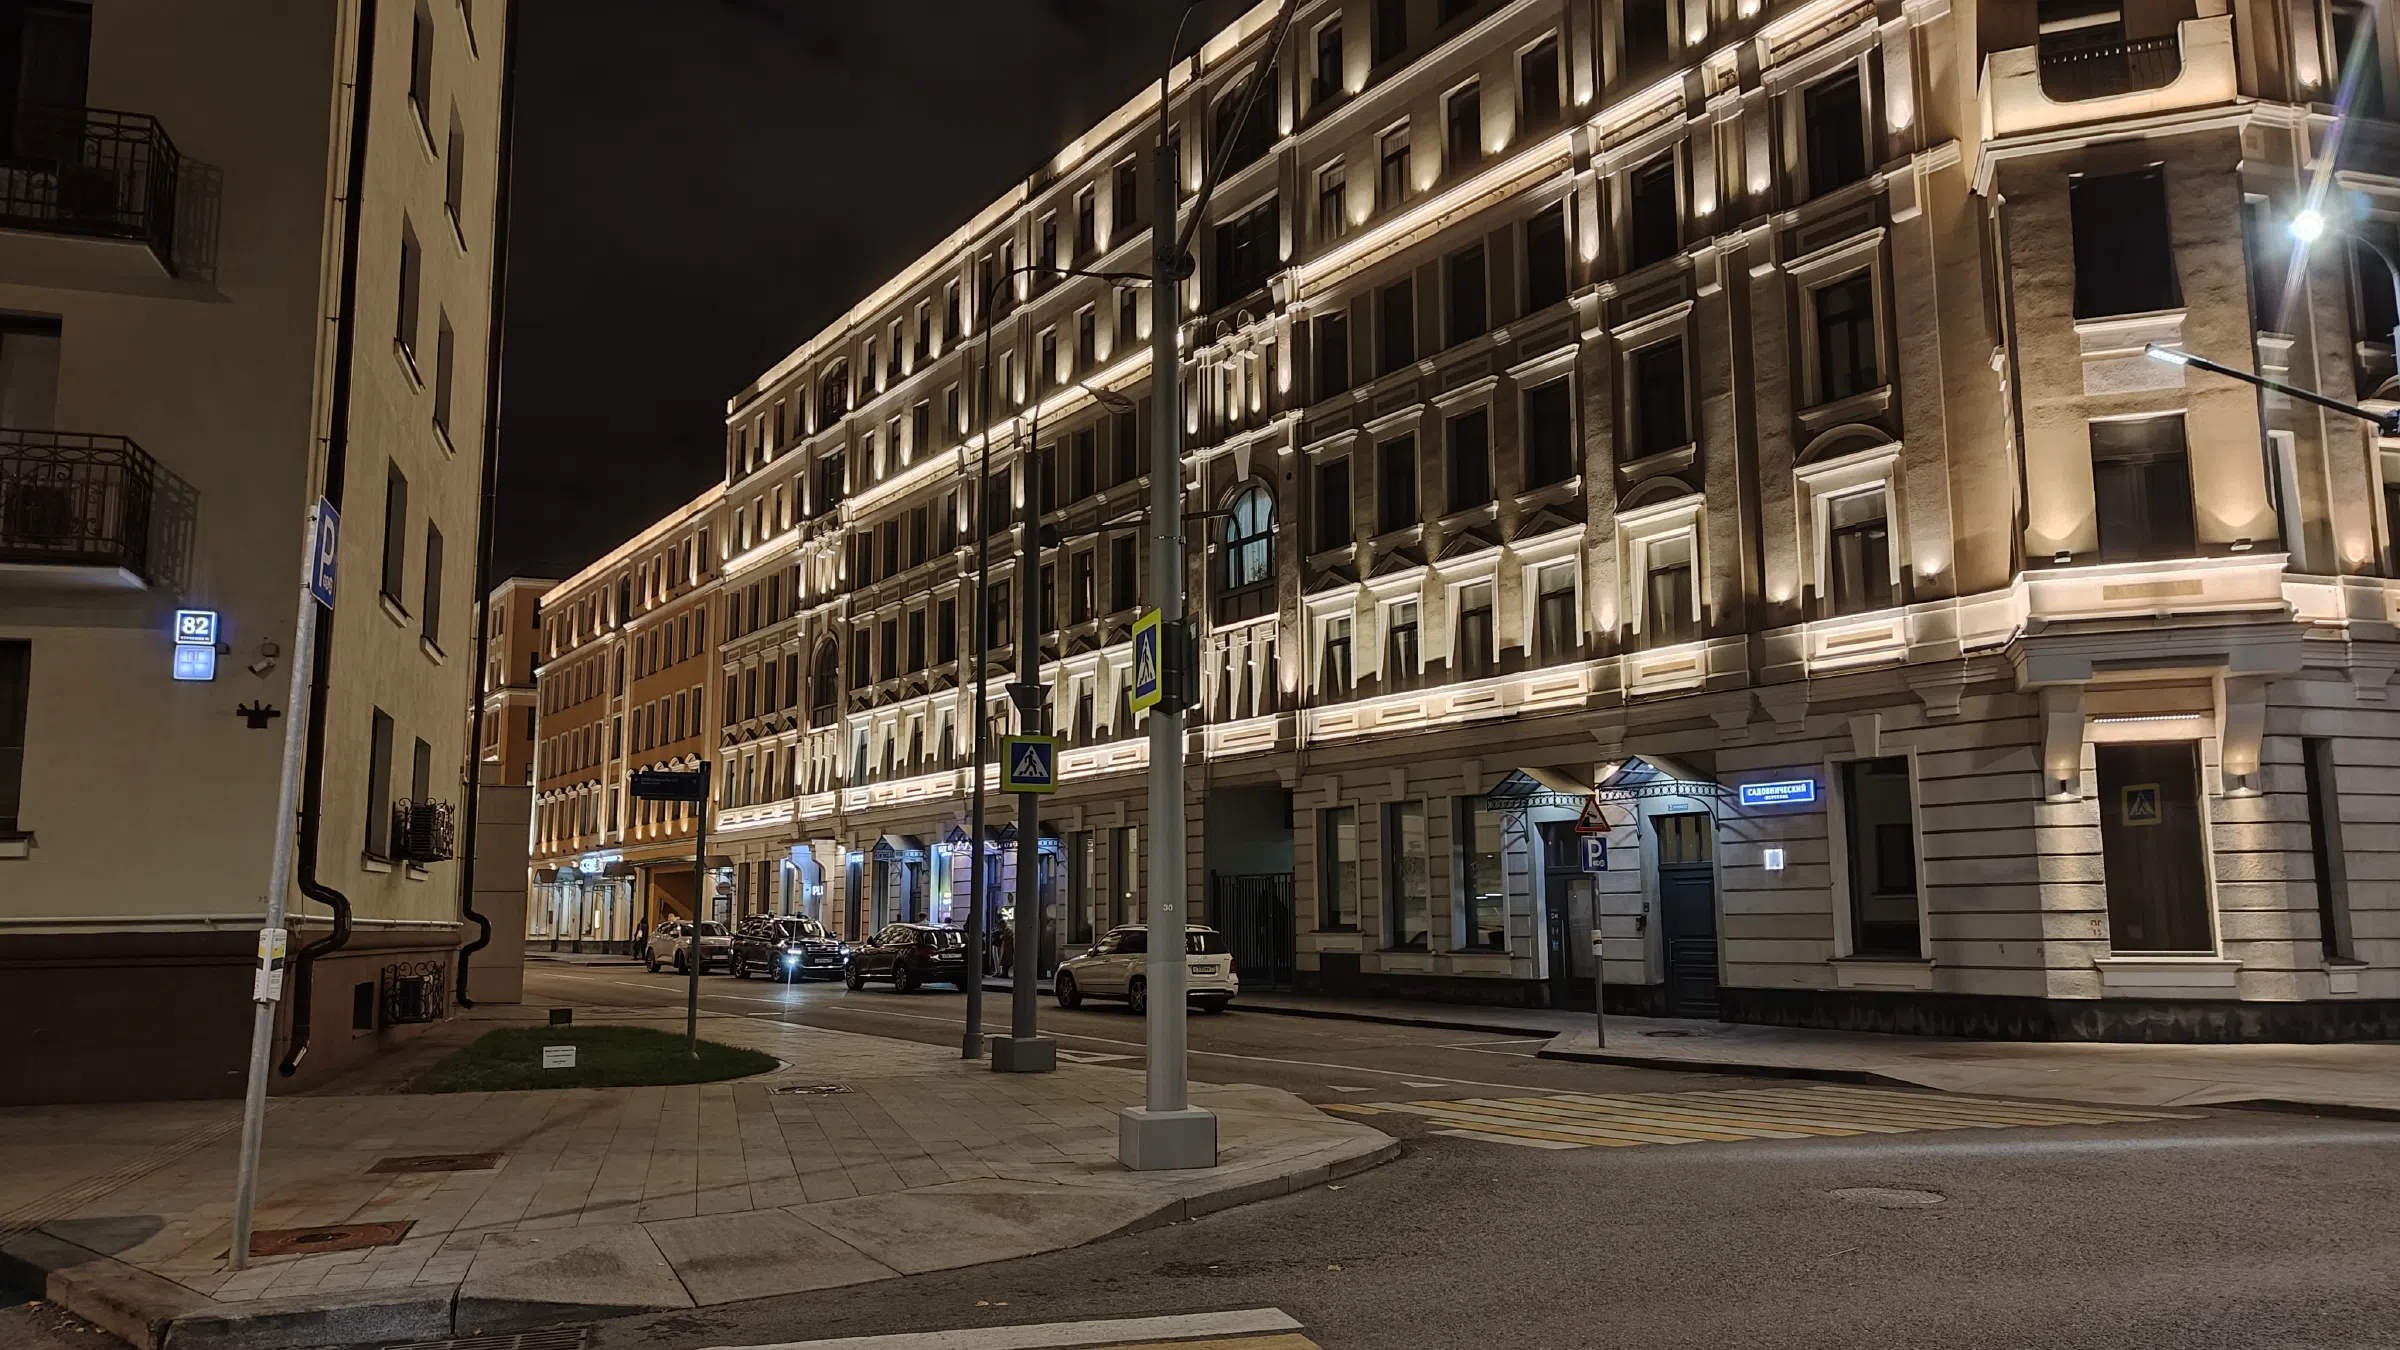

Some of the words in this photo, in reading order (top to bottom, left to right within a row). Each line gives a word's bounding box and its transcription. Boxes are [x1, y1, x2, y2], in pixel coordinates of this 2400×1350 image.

[182, 616, 209, 635] 82
[1747, 784, 1807, 797] САДОВНИЧЕСКИЙ
[1588, 839, 1603, 868] P
[1163, 903, 1173, 912] 30
